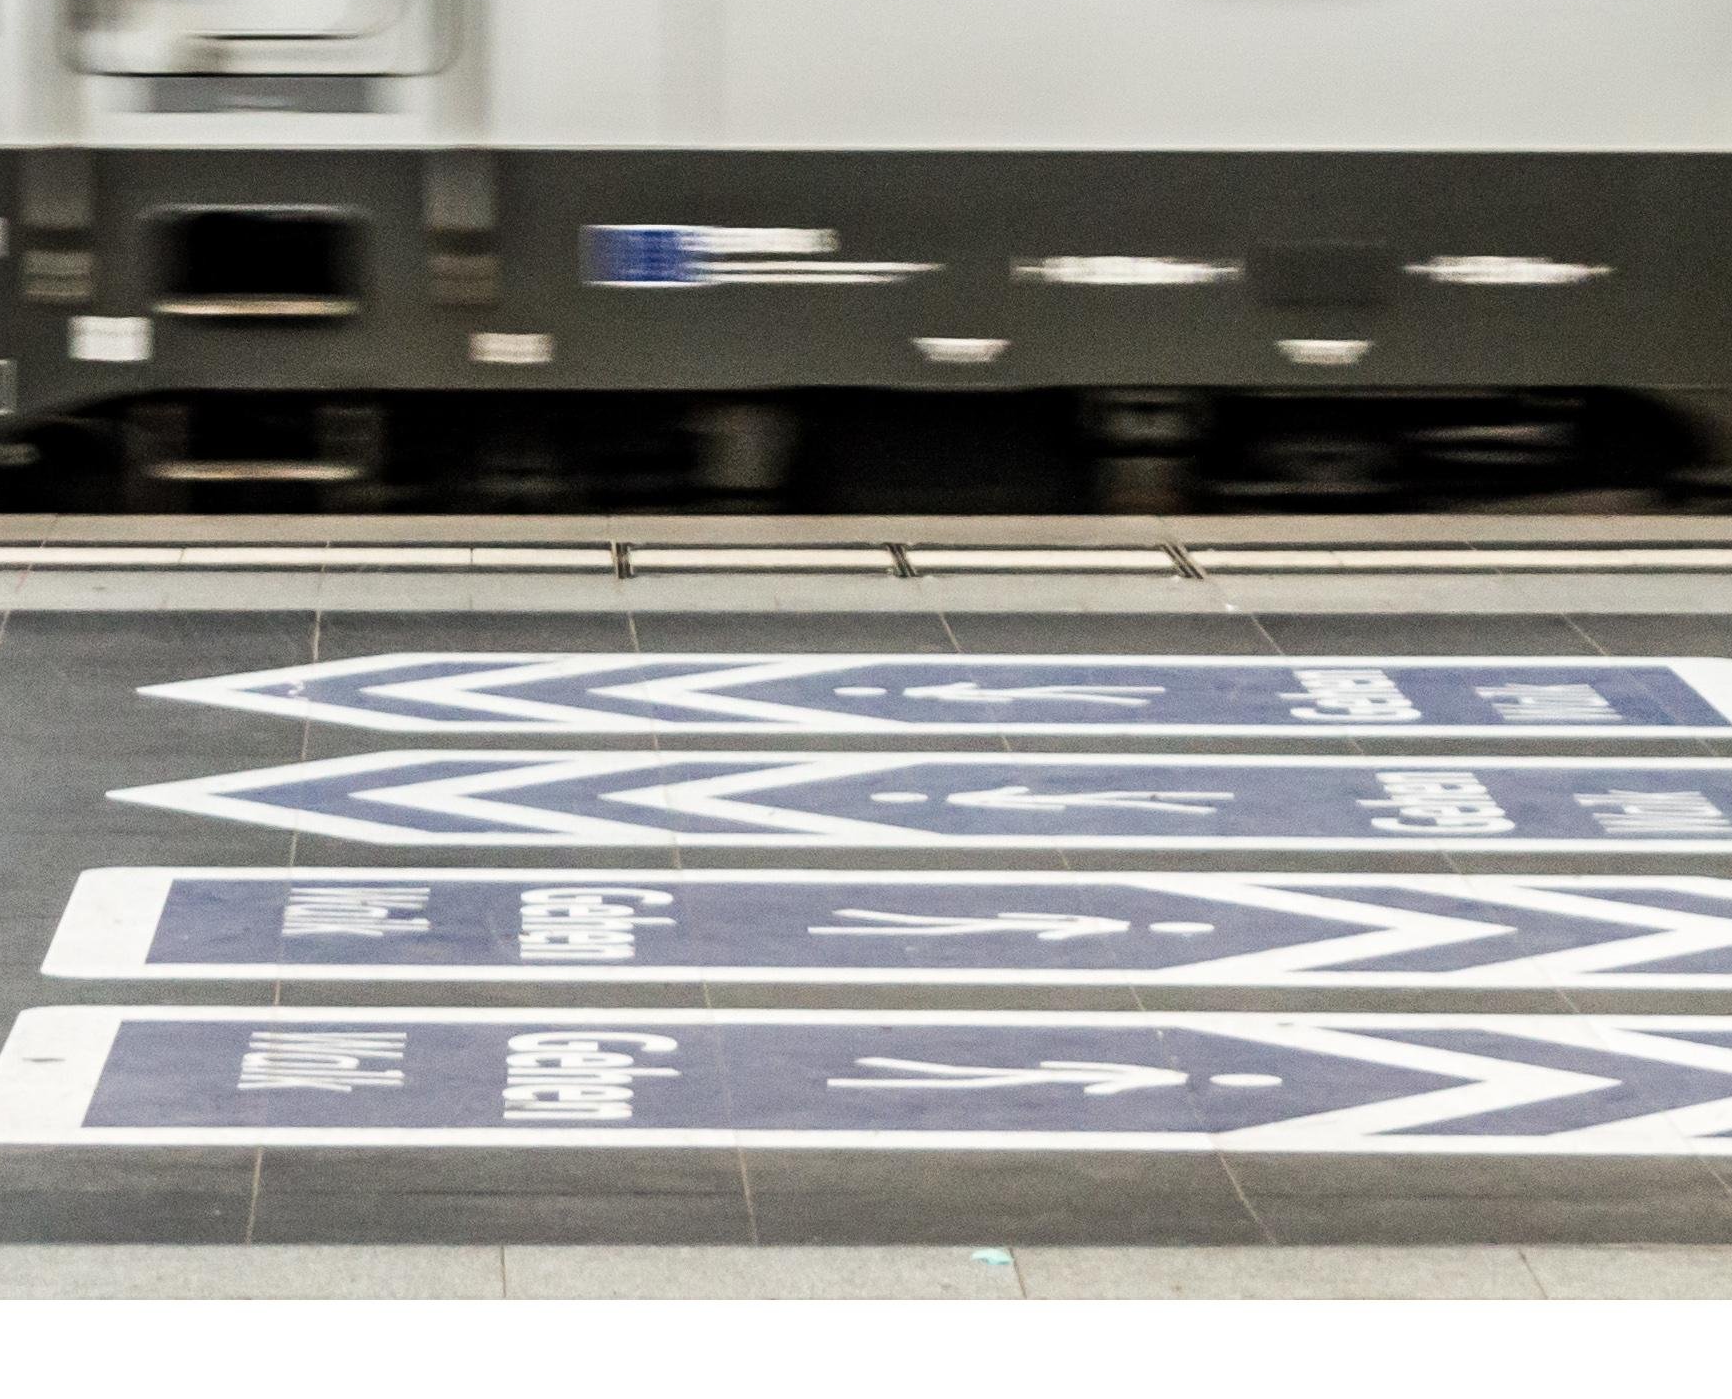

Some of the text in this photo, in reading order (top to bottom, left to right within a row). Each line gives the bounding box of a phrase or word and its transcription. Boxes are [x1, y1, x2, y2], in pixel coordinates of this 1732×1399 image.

[1279, 668, 1422, 723] Gehen
[1476, 683, 1624, 721] Walk
[1356, 771, 1516, 835] Gehen
[281, 887, 431, 937] Walk
[519, 886, 678, 960] Gehen
[236, 1031, 408, 1093] Walk
[502, 1031, 682, 1120] Gehen
